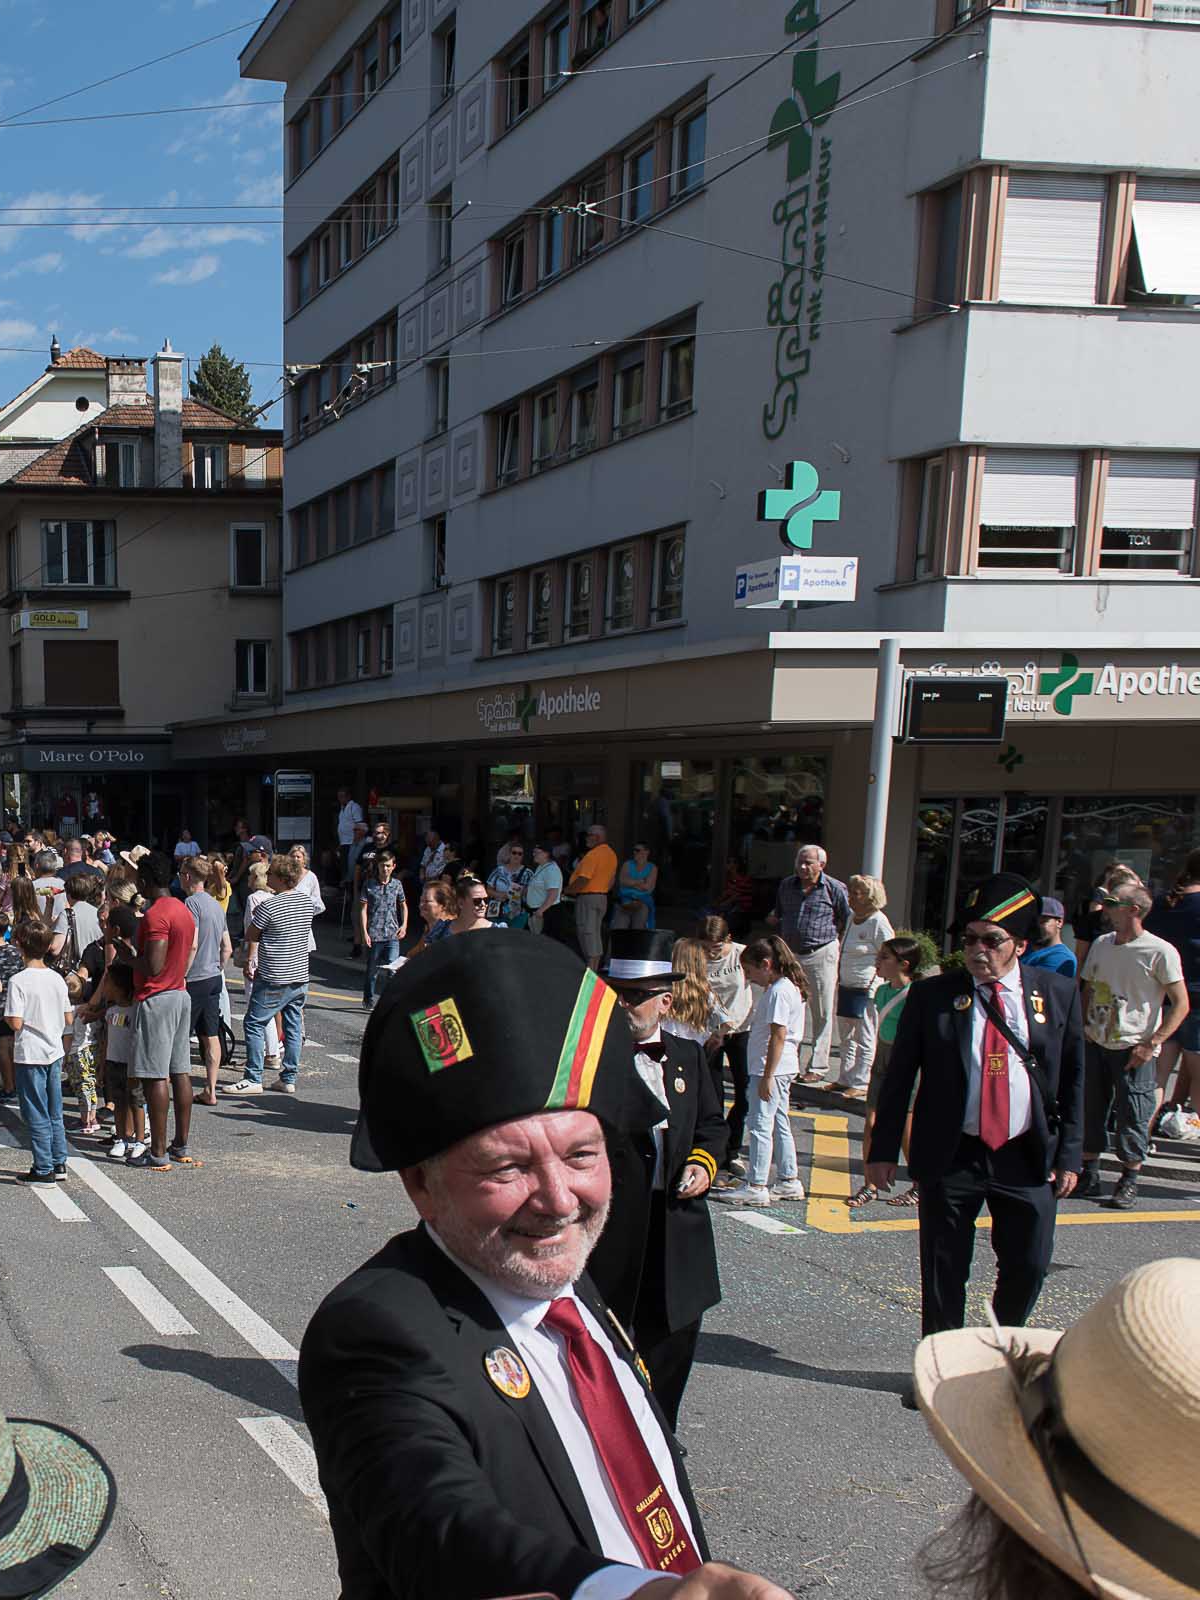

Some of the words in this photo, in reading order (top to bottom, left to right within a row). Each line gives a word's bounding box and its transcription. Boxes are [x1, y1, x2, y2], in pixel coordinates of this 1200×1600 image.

[812, 135, 832, 231] Natur
[811, 237, 827, 290] der
[807, 292, 823, 342] mit
[1128, 535, 1151, 545] TCM
[803, 579, 847, 587] Apotheke
[33, 614, 56, 622] GOLD
[537, 685, 601, 720] Apotheke
[1013, 697, 1050, 712] Natur
[39, 750, 84, 763] Marc
[90, 749, 145, 763] O'Polo
